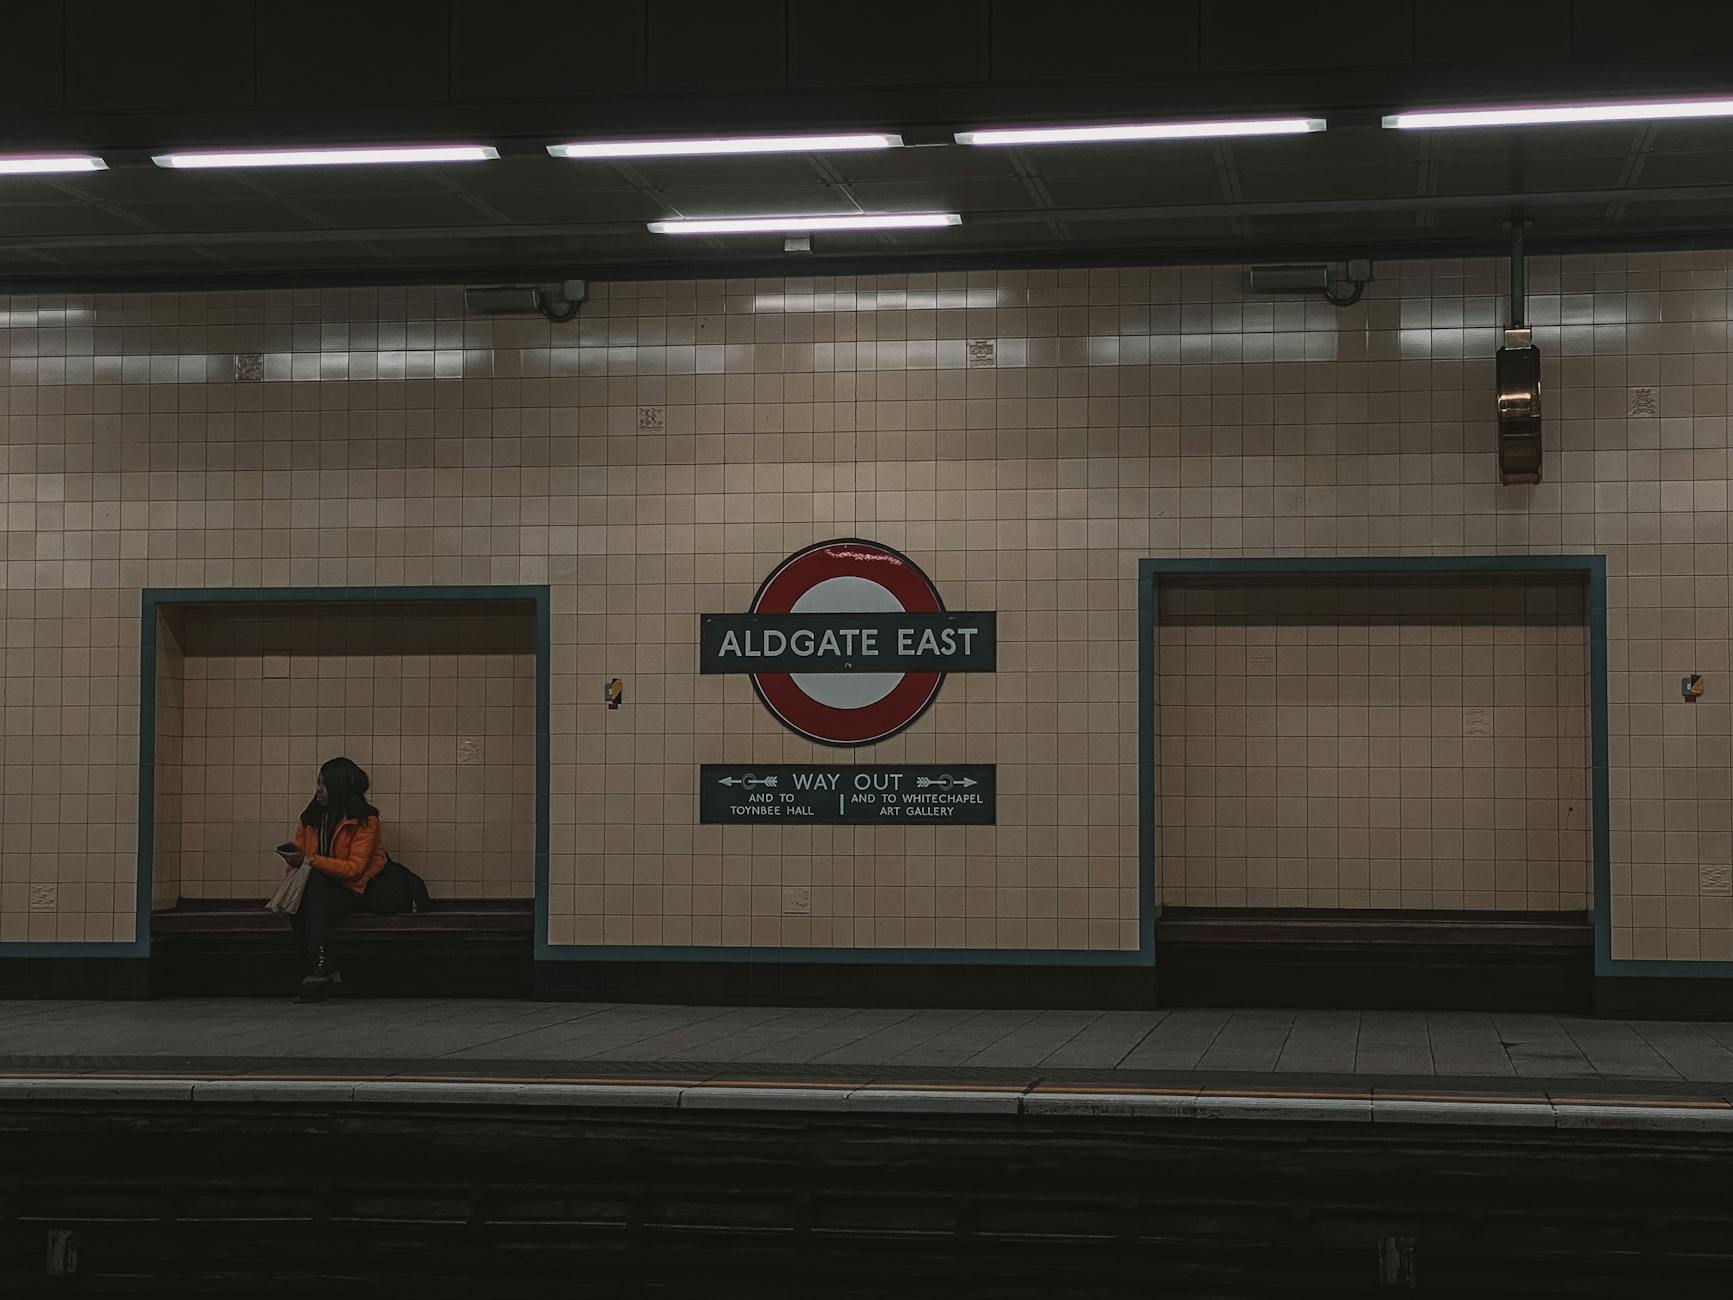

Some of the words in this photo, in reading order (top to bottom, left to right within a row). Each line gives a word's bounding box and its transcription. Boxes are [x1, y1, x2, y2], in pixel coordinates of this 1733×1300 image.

[718, 629, 879, 657] ALDGATE
[897, 628, 978, 656] EAST
[792, 773, 840, 791] WAY
[854, 773, 903, 791] OUT
[748, 793, 774, 803] AND
[779, 793, 795, 803] TO
[851, 793, 876, 803] AND
[881, 793, 897, 803] TO
[902, 793, 983, 804] WHITECHAPEL
[730, 806, 781, 816] TOYNBEE
[786, 806, 815, 816] HALL
[879, 806, 901, 816] ART
[905, 806, 954, 816] GALLERY
